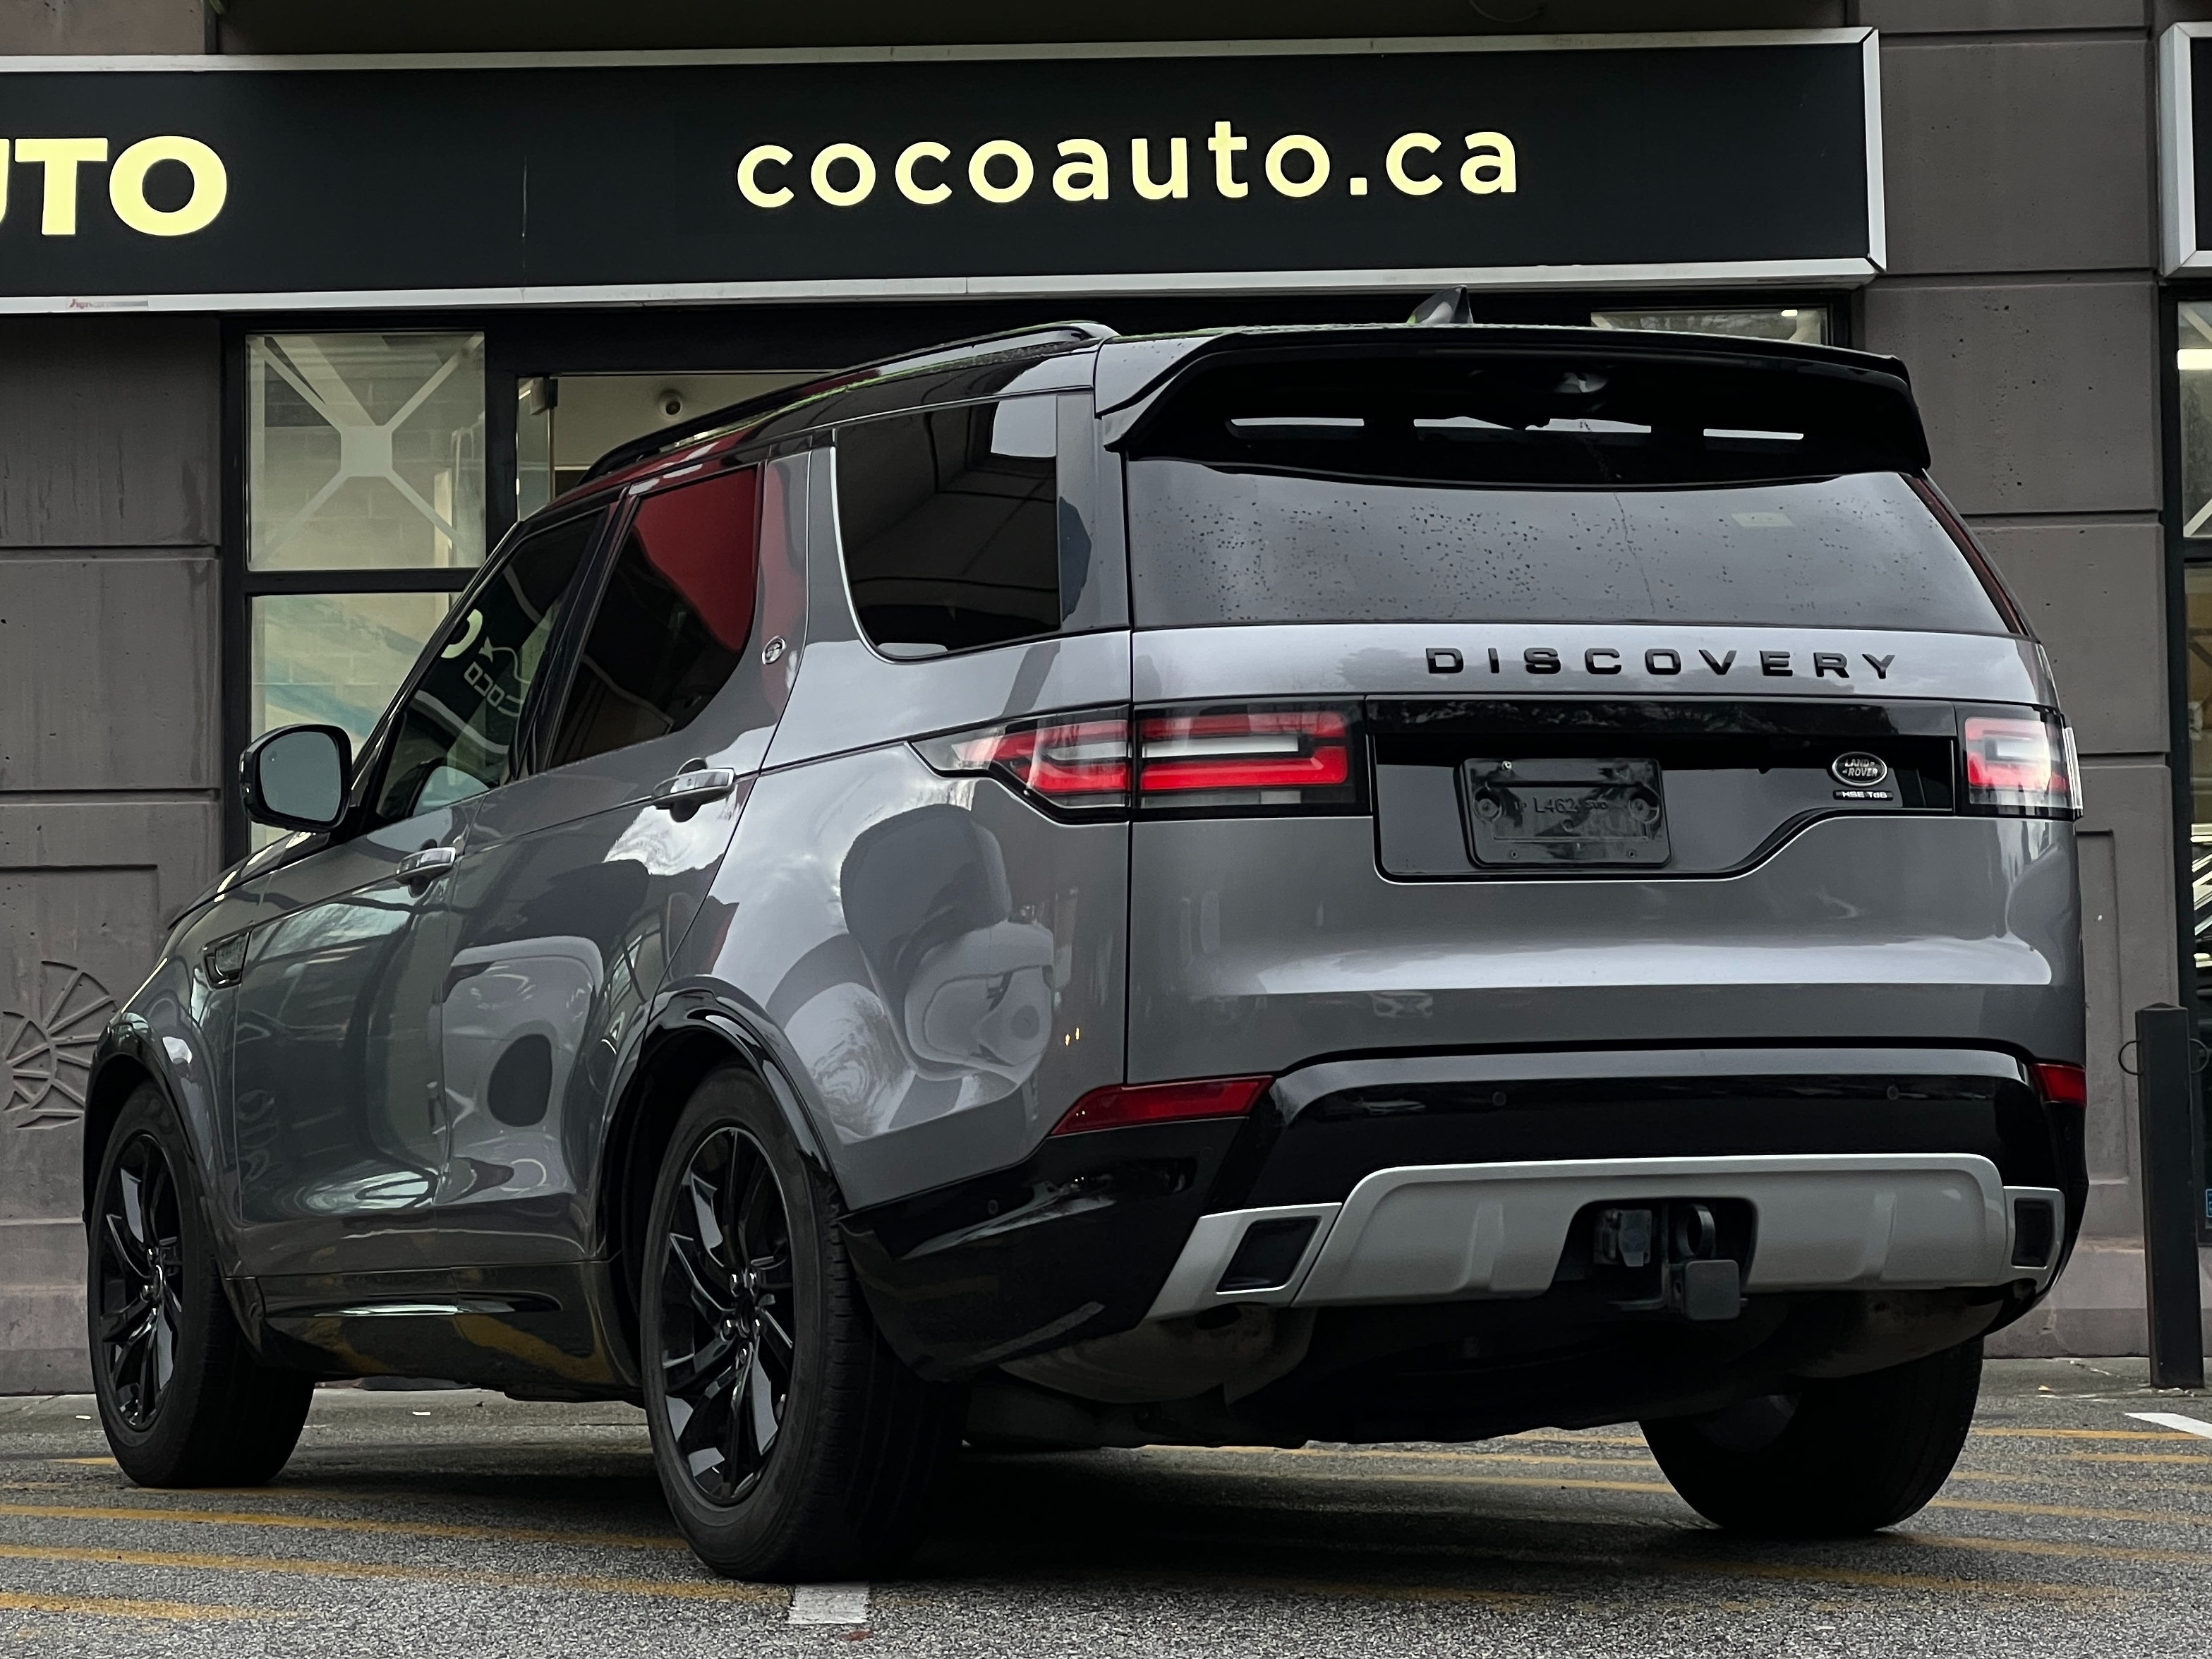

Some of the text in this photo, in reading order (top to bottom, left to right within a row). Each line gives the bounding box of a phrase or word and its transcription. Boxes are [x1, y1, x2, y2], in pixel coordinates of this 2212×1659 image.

[737, 121, 1518, 208] cocoauto.ca
[1426, 648, 1896, 680] DISCOVERY
[1844, 759, 1870, 768] LAND
[1847, 767, 1878, 777] ROVER
